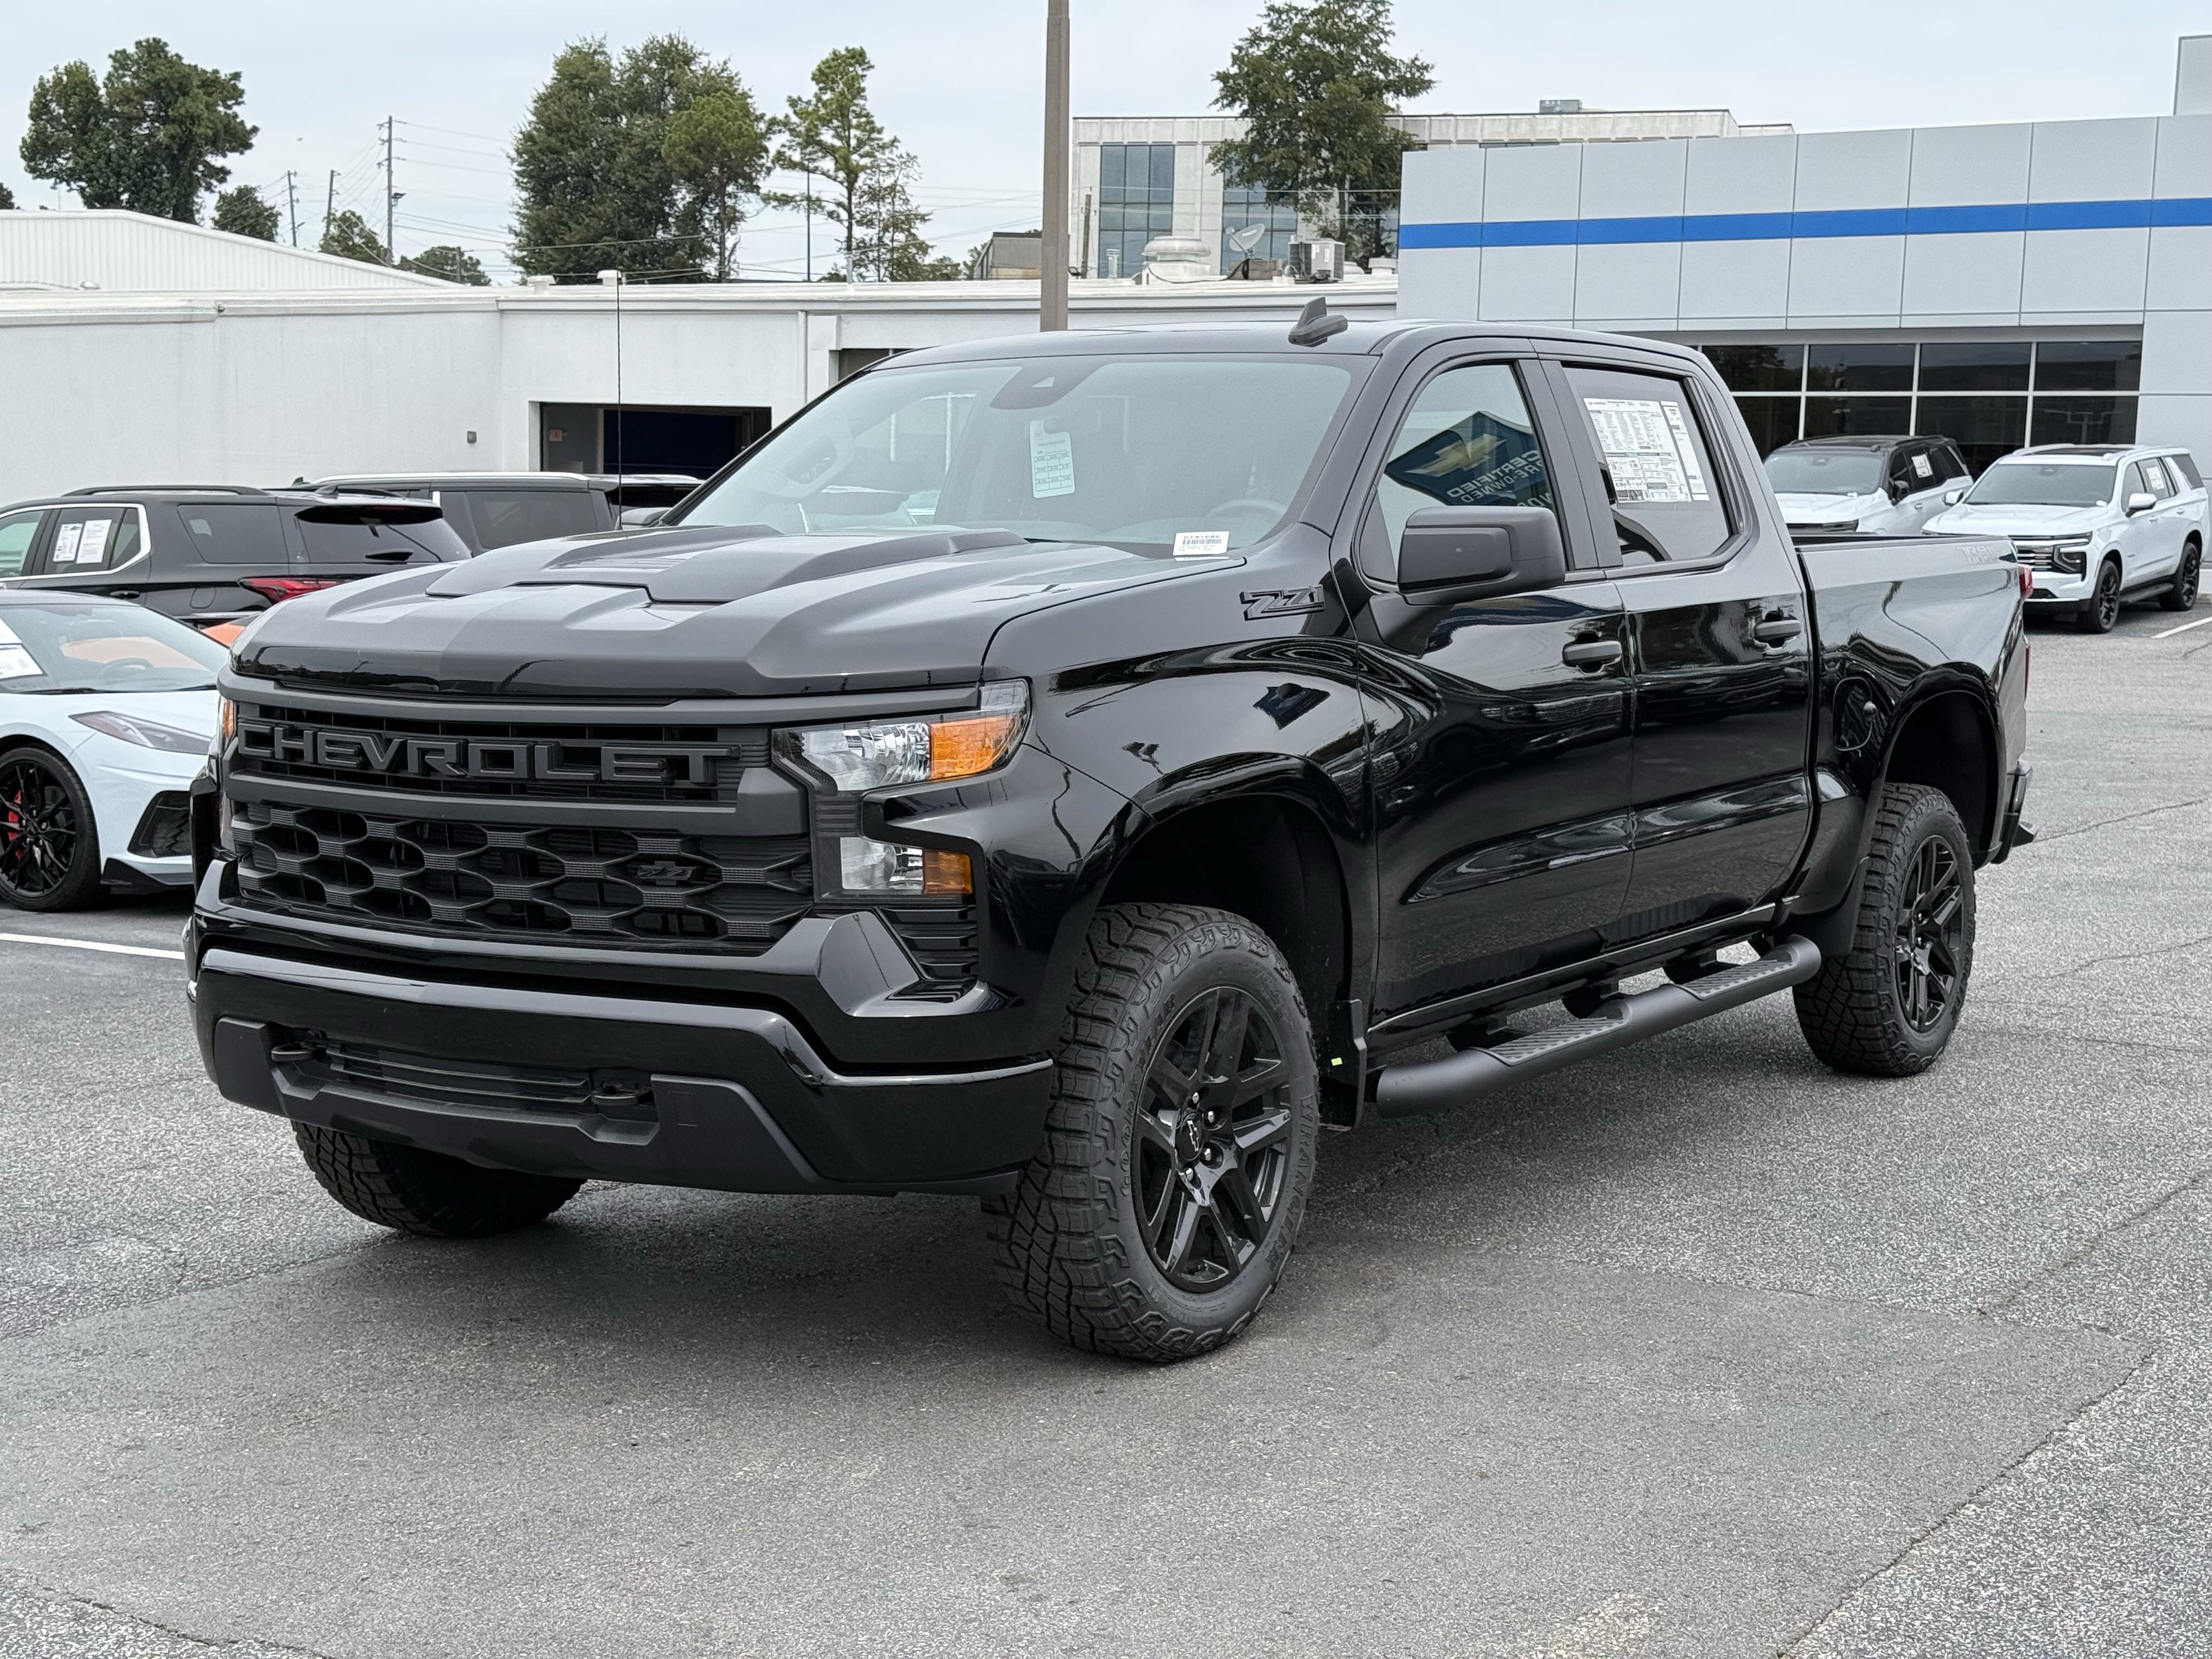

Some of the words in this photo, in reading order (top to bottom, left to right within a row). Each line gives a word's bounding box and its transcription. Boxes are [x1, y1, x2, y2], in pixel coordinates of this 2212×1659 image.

[1955, 545, 2001, 556] TRAIL
[1239, 584, 1325, 621] Z71
[238, 721, 740, 786] CHEVROLET
[1264, 1093, 1315, 1271] WRANGLER
